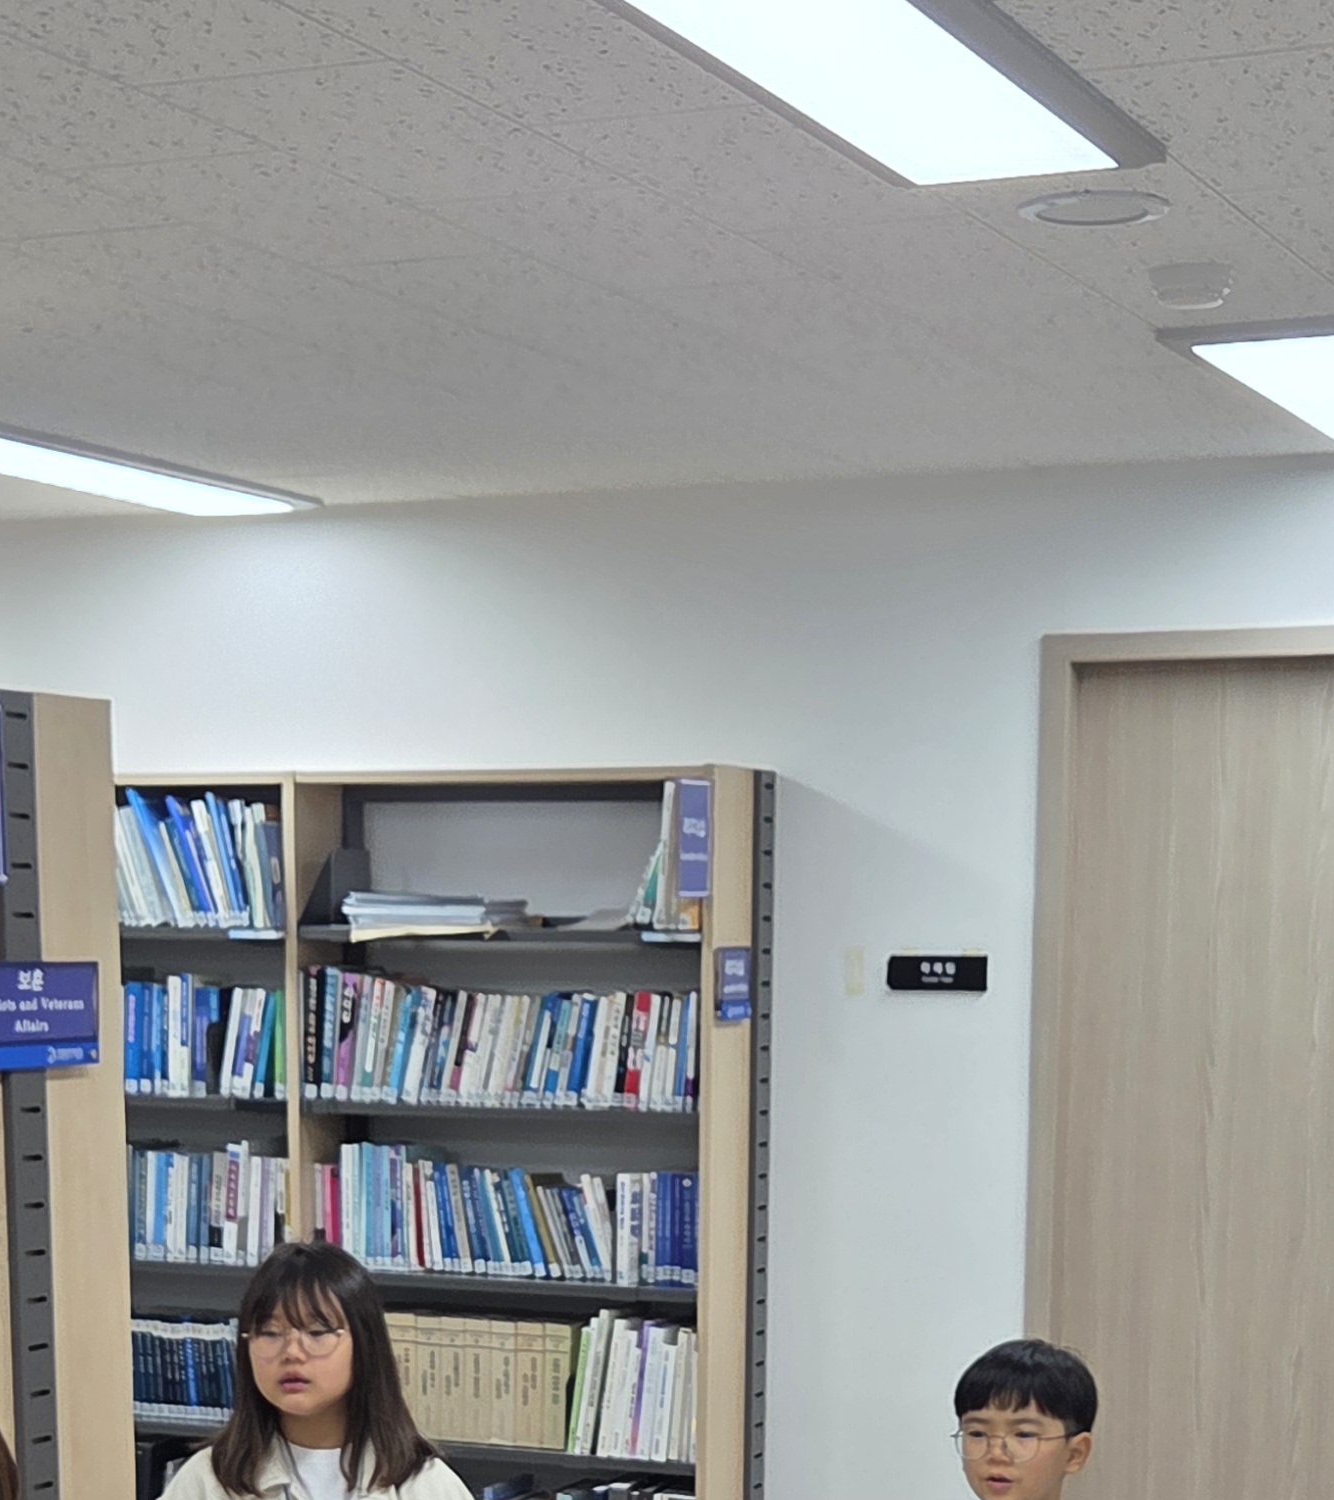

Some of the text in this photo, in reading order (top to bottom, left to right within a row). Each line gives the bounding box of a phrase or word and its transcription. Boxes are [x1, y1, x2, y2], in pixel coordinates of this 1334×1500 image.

[16, 967, 45, 992] 보훈
[18, 997, 39, 1012] and
[40, 996, 85, 1011] Veterans
[13, 1018, 50, 1034] Affairs
